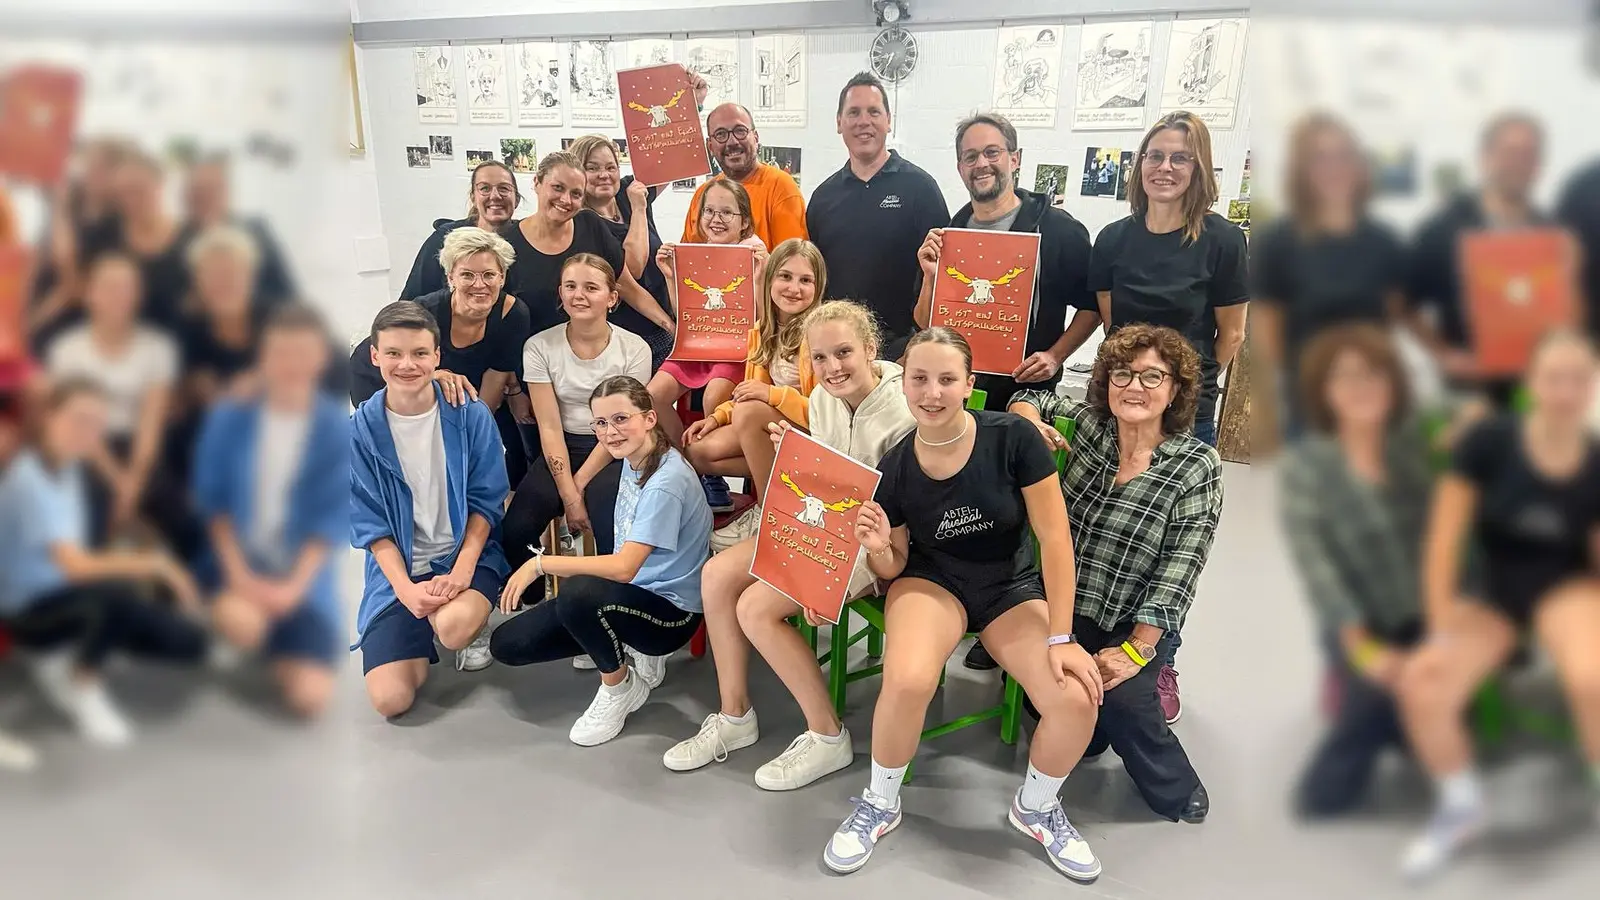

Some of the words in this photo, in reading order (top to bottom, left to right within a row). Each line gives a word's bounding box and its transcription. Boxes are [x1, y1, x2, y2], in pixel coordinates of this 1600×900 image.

[937, 507, 982, 532] Musical
[943, 505, 975, 520] ABTEI-
[935, 520, 994, 540] COMPANY
